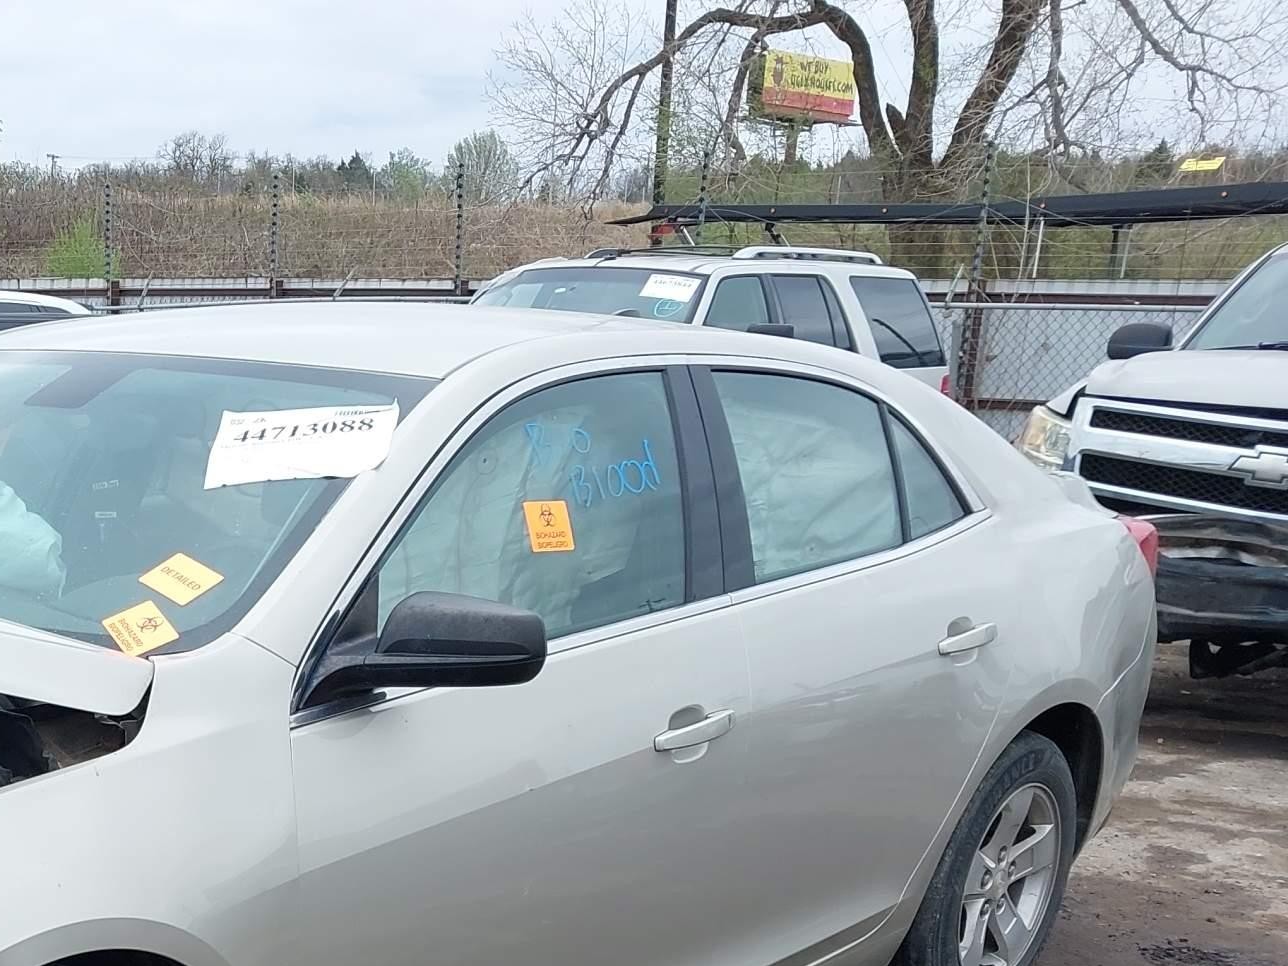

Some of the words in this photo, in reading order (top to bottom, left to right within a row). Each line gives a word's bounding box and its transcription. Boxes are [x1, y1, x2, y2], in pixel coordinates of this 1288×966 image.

[800, 62, 812, 73] WE
[814, 61, 829, 74] BUY
[233, 418, 374, 442] 44713088
[160, 566, 201, 591] DETAILED
